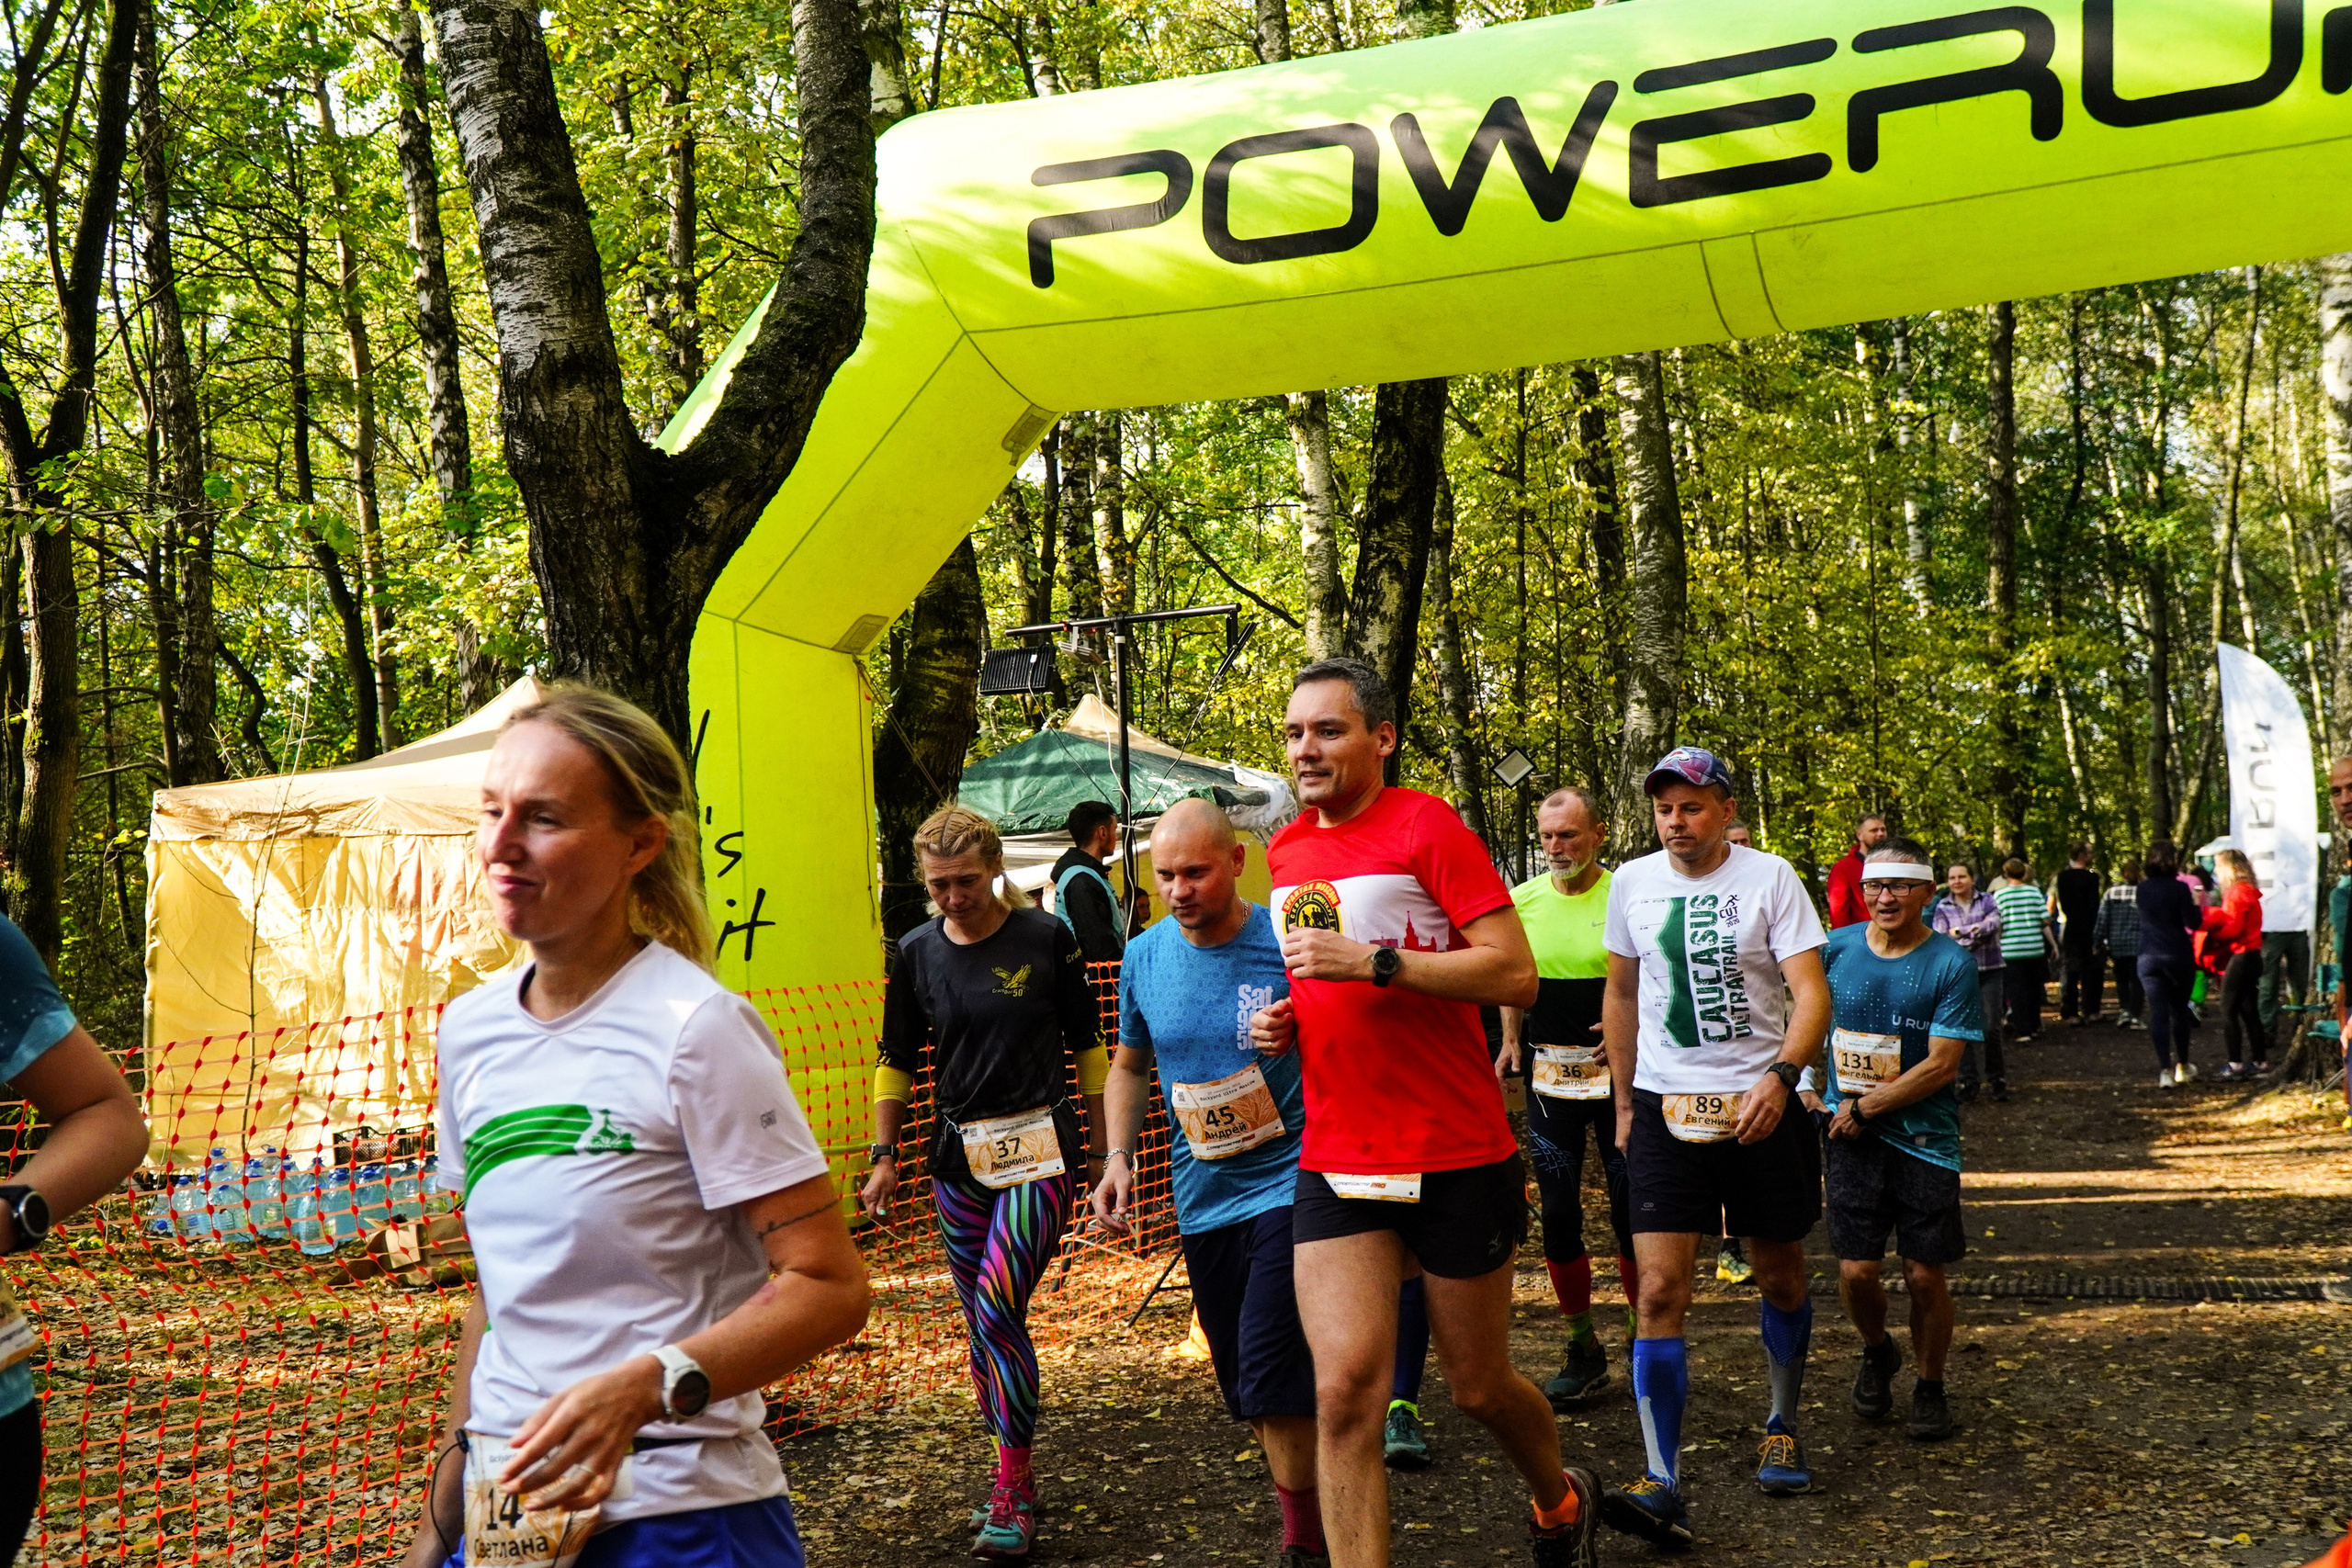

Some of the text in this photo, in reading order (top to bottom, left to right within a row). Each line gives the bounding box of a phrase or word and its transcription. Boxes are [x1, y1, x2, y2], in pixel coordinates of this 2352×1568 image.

[1283, 882, 1339, 911] SPARTAK MOSCOW
[1719, 906, 1738, 919] CUT
[1690, 894, 1732, 1043] CAUCASUS
[1012, 988, 1023, 998] 50
[1238, 984, 1273, 1010] Sat
[1893, 1014, 1902, 1026] U
[1842, 1052, 1873, 1070] 131
[1561, 1064, 1582, 1077] 36
[1223, 1089, 1238, 1097] Ultra
[1696, 1096, 1723, 1114] 89
[1206, 1105, 1235, 1127] 45
[1685, 1114, 1731, 1126] Евгений
[1205, 1122, 1247, 1140] Андрей
[996, 1137, 1020, 1158] 37
[990, 1155, 1035, 1171] Людмила
[486, 1488, 524, 1530] 14
[474, 1536, 549, 1559] Светлана
